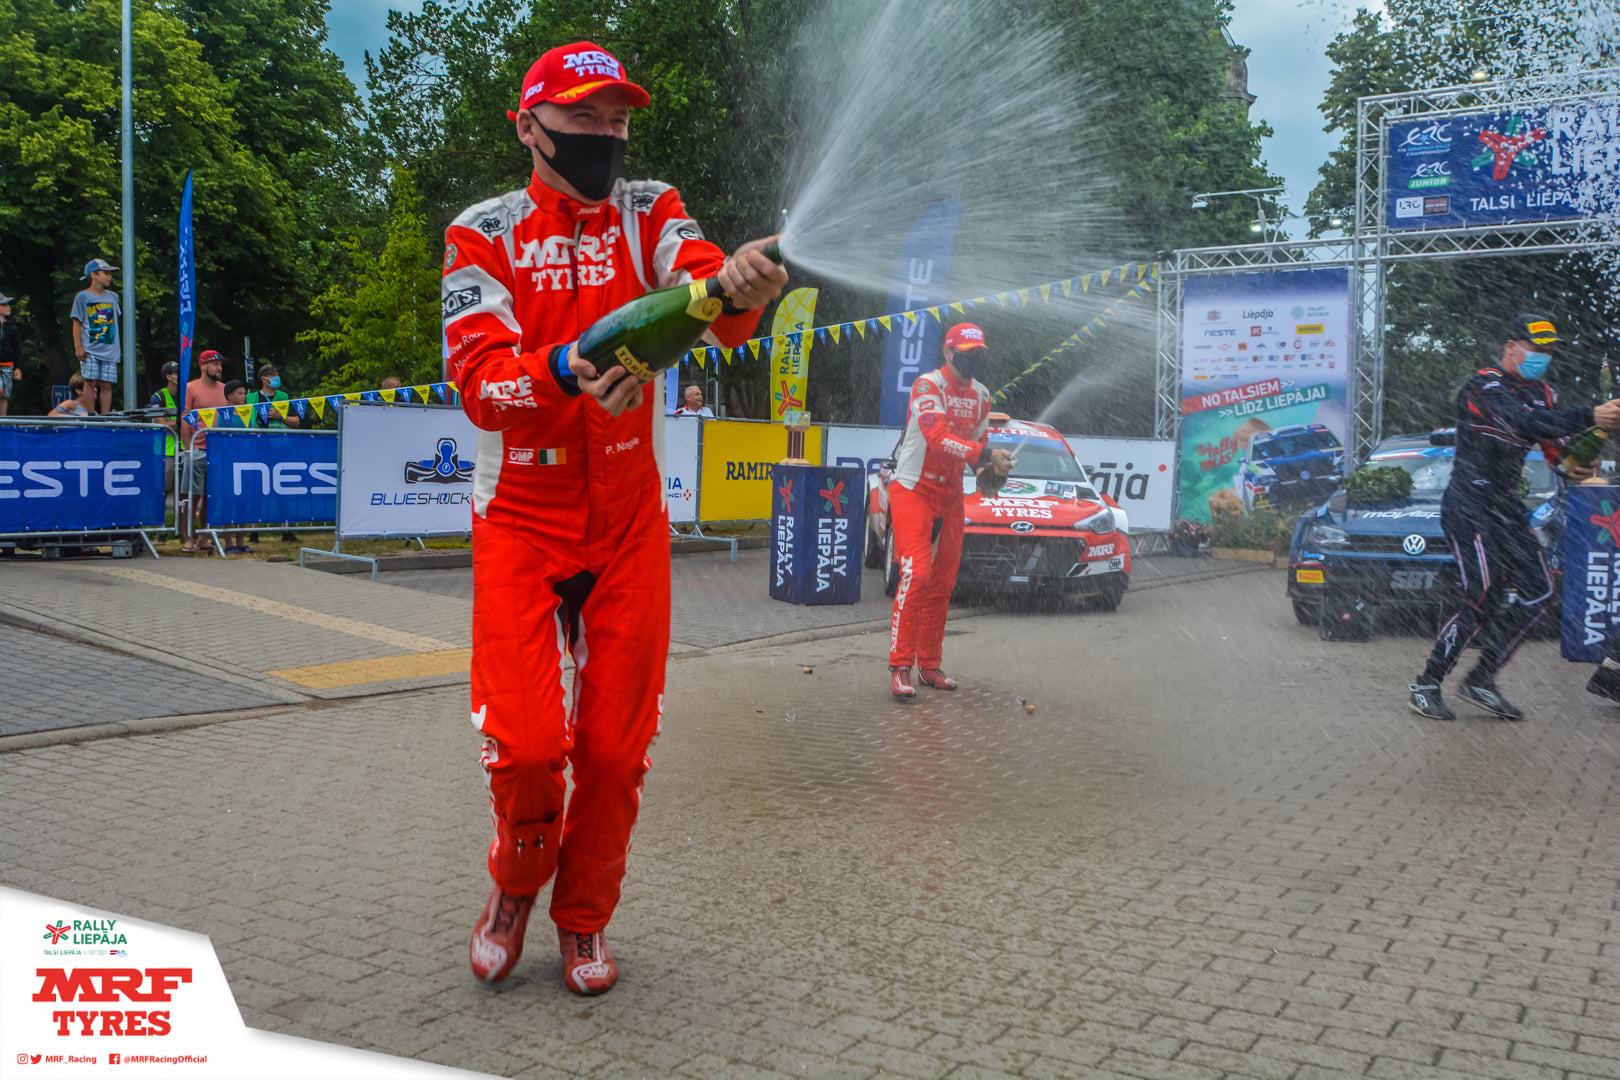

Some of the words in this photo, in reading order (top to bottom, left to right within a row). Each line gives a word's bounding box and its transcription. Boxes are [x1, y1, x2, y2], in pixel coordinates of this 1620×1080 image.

[1411, 178, 1447, 188] JUNIOR
[1470, 195, 1516, 211] TALSI
[780, 331, 791, 374] RALL
[1201, 393, 1221, 408] NO
[1222, 380, 1280, 402] TALSIEM
[1234, 398, 1264, 416] LĪDZ
[1267, 386, 1326, 410] LIEPĀJAI
[509, 450, 534, 462] OMP
[666, 477, 683, 490] IA
[371, 492, 471, 506] BLUESHOCK
[992, 508, 1053, 519] TYRES
[777, 515, 787, 587] LIEPĀJA
[784, 516, 794, 575] RALLY
[816, 518, 834, 592] LIEPĀJA
[833, 518, 848, 577] RALLY
[1088, 543, 1115, 557] MRF
[1583, 552, 1611, 646] LIEPĀJA
